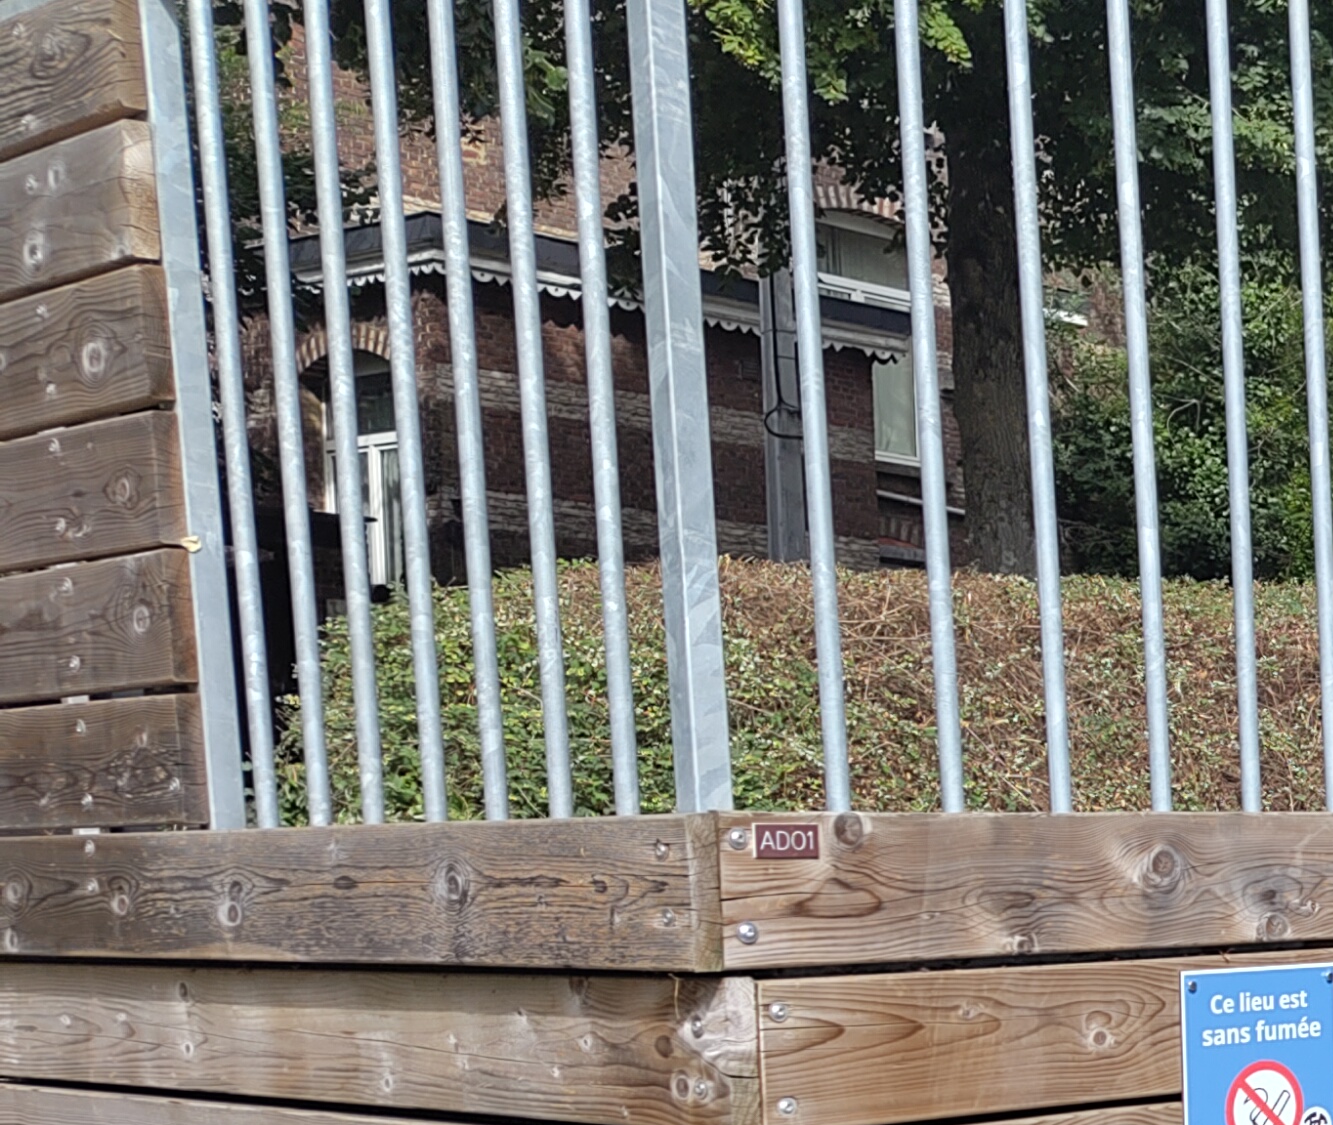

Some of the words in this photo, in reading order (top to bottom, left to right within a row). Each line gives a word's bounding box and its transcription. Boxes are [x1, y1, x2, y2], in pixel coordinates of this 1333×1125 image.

[1210, 994, 1235, 1015] Ce
[1239, 991, 1275, 1013] lieu
[1278, 990, 1308, 1010] est
[1201, 1024, 1251, 1047] sans
[1255, 1016, 1321, 1042] fumée
